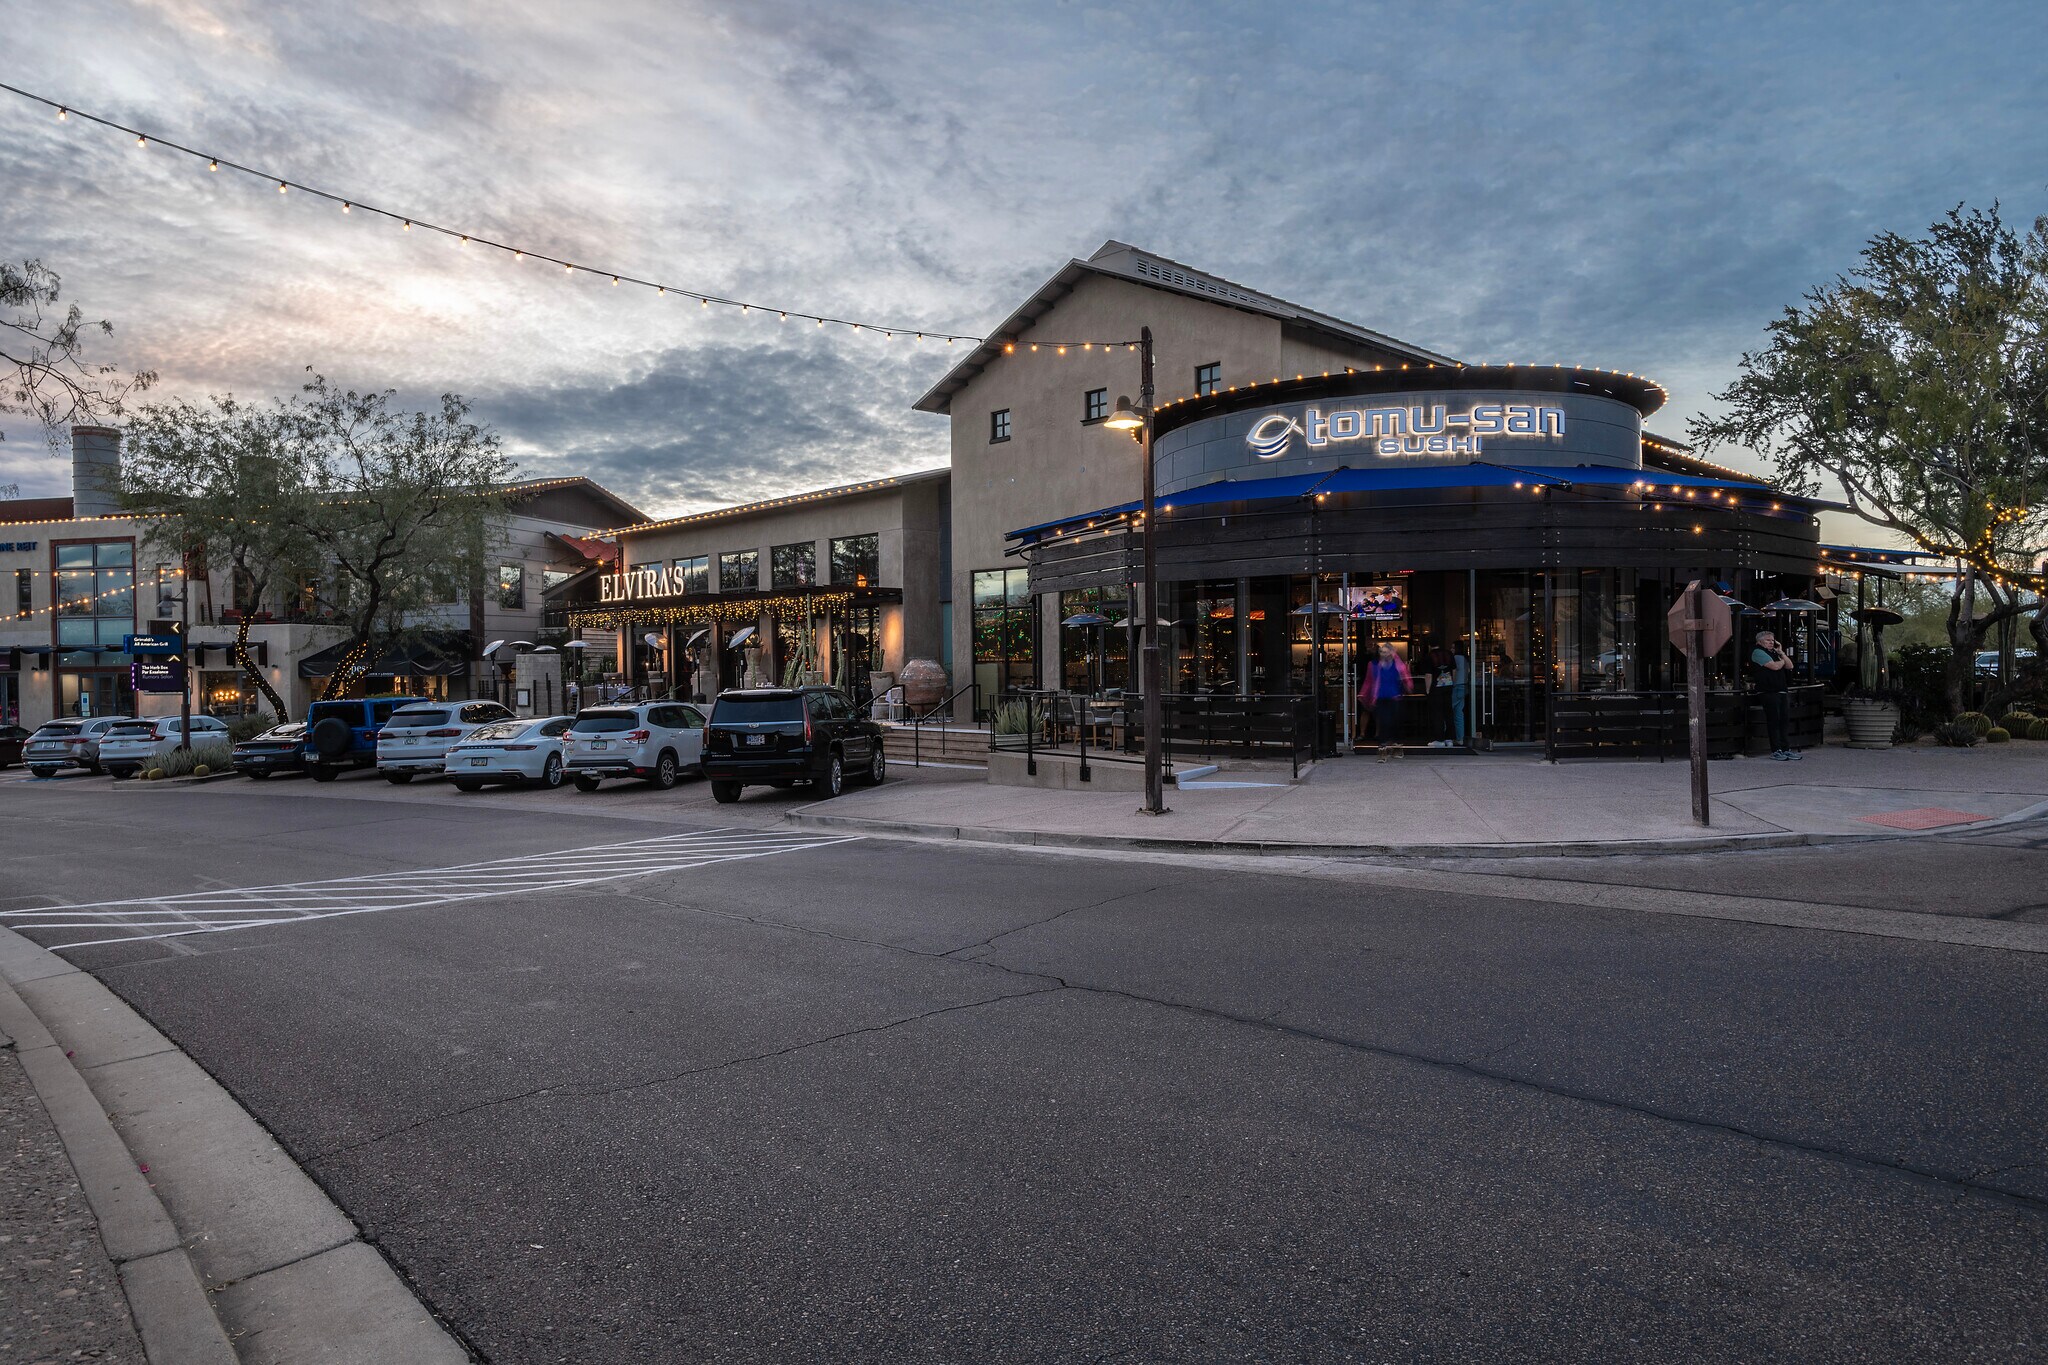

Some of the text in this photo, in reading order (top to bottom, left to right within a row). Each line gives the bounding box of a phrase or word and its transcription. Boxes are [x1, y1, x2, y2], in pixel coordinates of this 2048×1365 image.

[1307, 405, 1566, 446] tomu-san
[1379, 436, 1483, 454] SUSHI
[600, 566, 685, 602] ELVIRA'S
